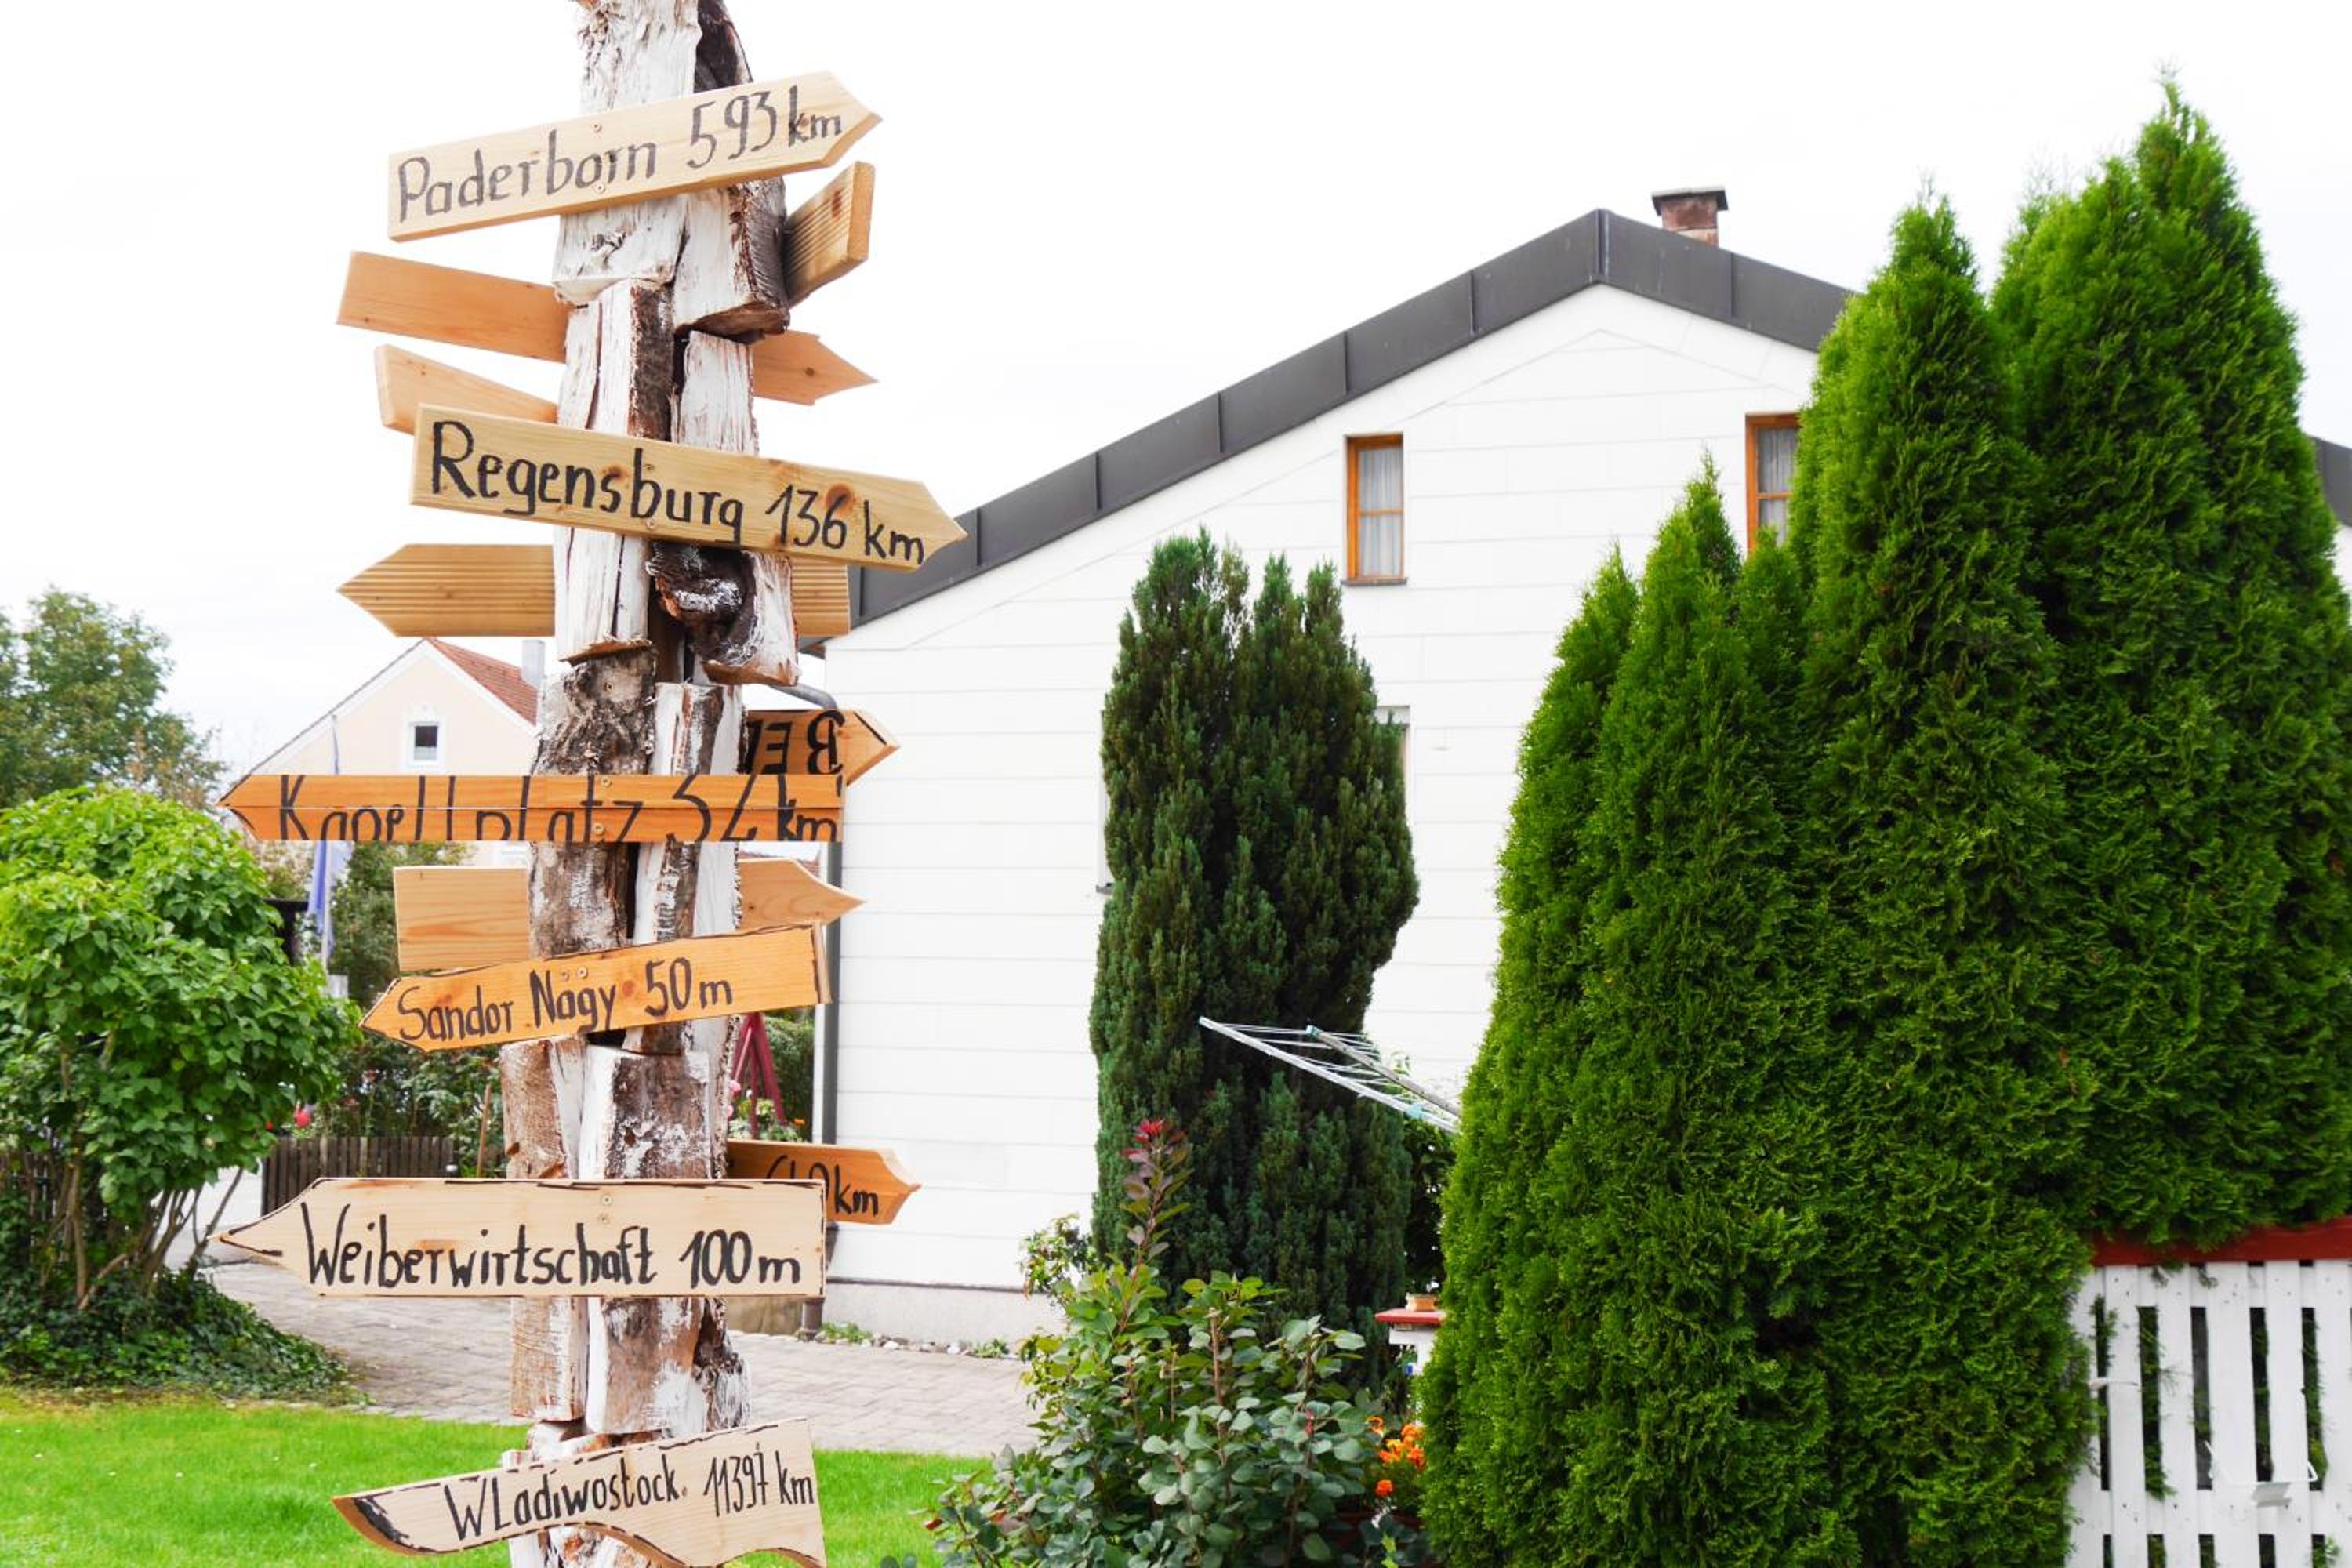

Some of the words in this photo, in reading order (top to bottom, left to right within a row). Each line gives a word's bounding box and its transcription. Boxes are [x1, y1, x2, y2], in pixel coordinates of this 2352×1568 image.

[398, 129, 656, 223] Paderborn
[687, 91, 777, 168] 593
[789, 85, 841, 147] km
[432, 421, 743, 545] Regensburg
[765, 484, 847, 549] 136
[864, 499, 924, 564] km
[777, 774, 837, 841] km
[397, 985, 514, 1042] Sandor
[529, 969, 615, 1033] Nagy
[644, 956, 692, 1017] 50
[699, 978, 733, 1009] m
[834, 1164, 879, 1217] km
[301, 1202, 657, 1287] Weiberwirtschaft
[679, 1229, 752, 1289] 100
[758, 1256, 800, 1283] m
[703, 1450, 768, 1517] 11397
[775, 1450, 815, 1504] km
